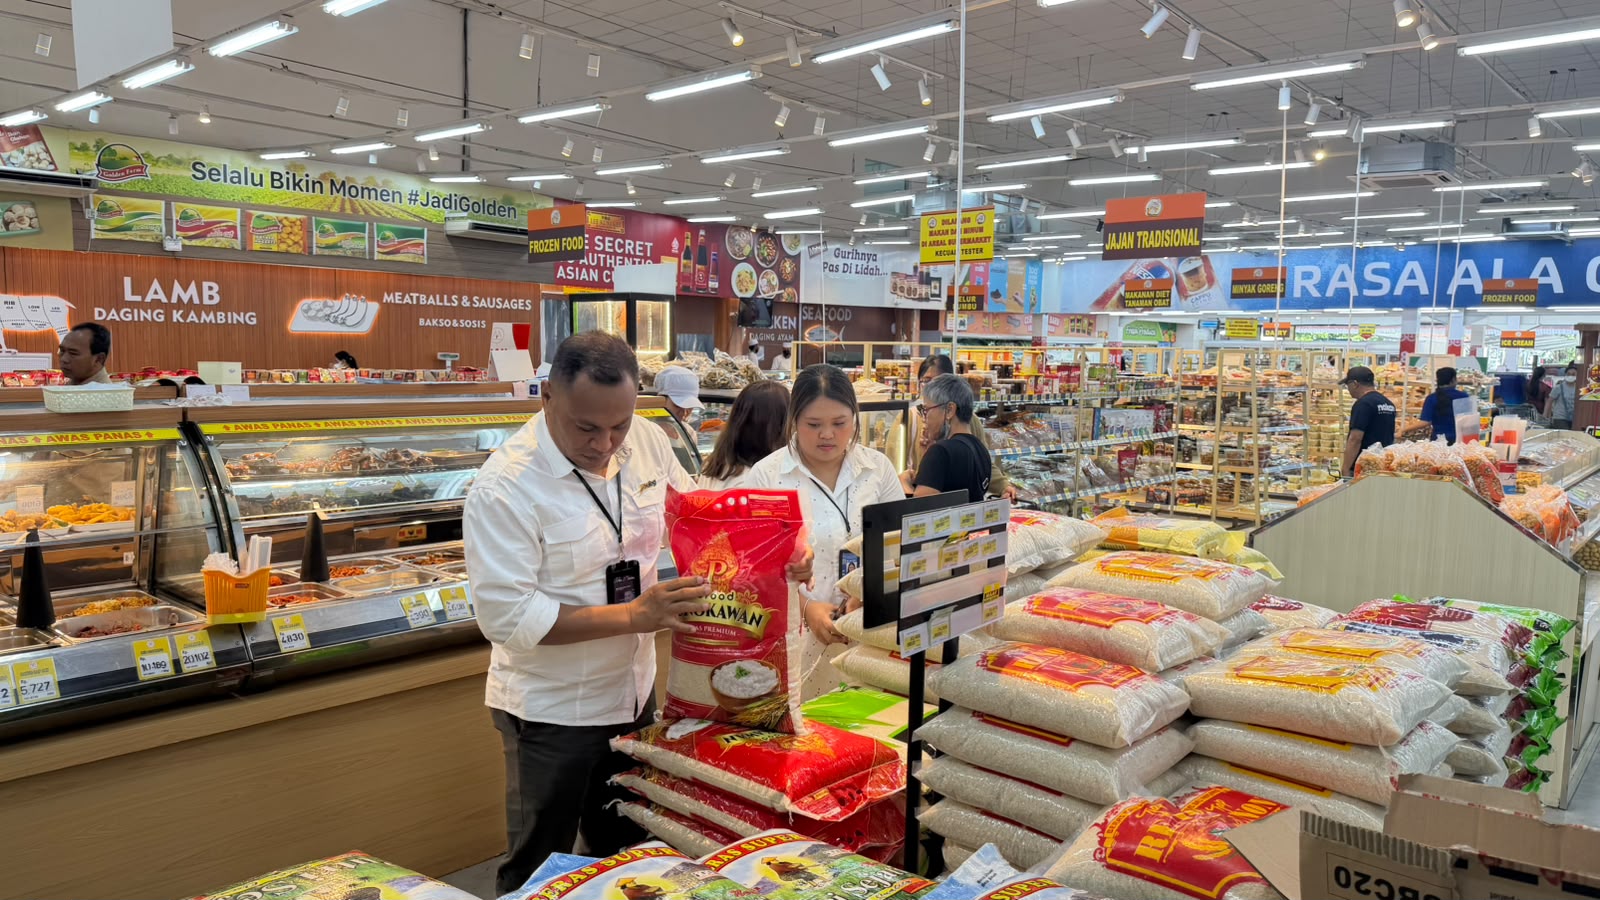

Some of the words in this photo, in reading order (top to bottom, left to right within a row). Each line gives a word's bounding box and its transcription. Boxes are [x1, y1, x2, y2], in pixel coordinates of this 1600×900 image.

[103, 170, 125, 178] Golden
[126, 168, 142, 177] Farm
[191, 161, 264, 189] Selalu
[270, 170, 324, 195] Bikin
[330, 180, 403, 204] Momen
[407, 189, 518, 220] #JadiGolden
[929, 229, 949, 237] MAKAN
[963, 226, 984, 234] MINUM
[1105, 231, 1134, 251] JAJAN
[1136, 228, 1200, 249] TRADISIONAL
[529, 239, 561, 255] FROZEN
[562, 236, 584, 252] FOOD
[594, 235, 654, 257] SECRET
[921, 240, 928, 248] DI
[928, 239, 947, 247] AREAL
[961, 247, 984, 256] TESTER
[833, 248, 877, 264] Gurihnya
[557, 266, 599, 283] ASIAN
[823, 262, 840, 274] Pas
[842, 262, 852, 274] Di
[854, 265, 888, 278] Lidah...
[1293, 261, 1430, 299] RASA
[123, 276, 221, 306] LAMB
[1125, 291, 1155, 299] MAKANAN
[1156, 290, 1170, 298] DIET
[1232, 283, 1257, 294] MINYAK
[383, 292, 459, 307] MEATBALLS
[461, 295, 471, 308] &
[472, 297, 532, 311] SAUSAGES
[1125, 299, 1153, 308] TANAMAN
[1153, 299, 1170, 307] OBAT
[1482, 294, 1513, 303] FROZEN
[1514, 293, 1536, 302] FOOD
[94, 308, 166, 322] DAGING
[172, 311, 258, 326] KAMBING
[802, 306, 852, 321] SEAFOOD
[749, 332, 775, 341] DAGING
[777, 333, 794, 341] AYAM
[234, 421, 270, 431] AWAS
[272, 421, 310, 430] PANAS
[324, 419, 357, 428] AWAS
[359, 418, 394, 427] PANAS
[406, 417, 435, 425] AWAS
[438, 416, 469, 424] PANAS
[479, 415, 505, 423] AWAS
[47, 433, 89, 443] AWAS
[93, 431, 142, 441] PANAS
[703, 625, 736, 637] PREMIUM
[744, 833, 805, 851] SUPER
[601, 847, 675, 868] SUPER
[989, 878, 1056, 900] SUPER
